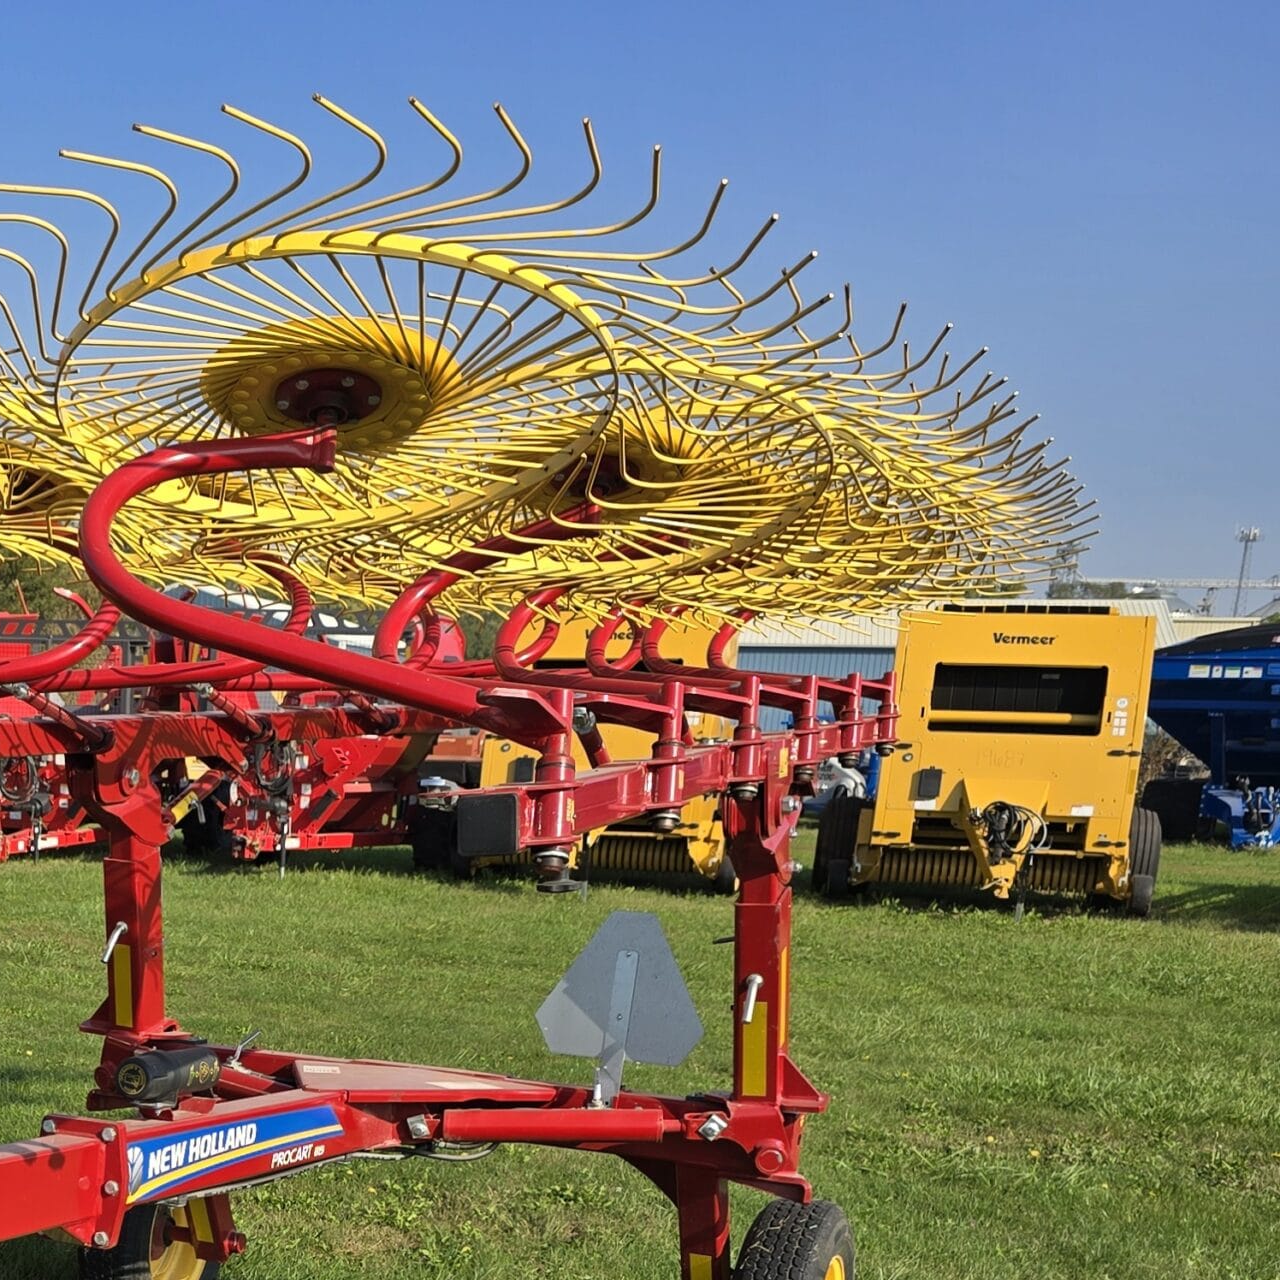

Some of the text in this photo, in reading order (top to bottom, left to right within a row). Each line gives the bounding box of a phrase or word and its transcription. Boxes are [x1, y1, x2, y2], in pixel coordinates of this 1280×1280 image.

[993, 632, 1056, 645] Vermeer
[147, 1123, 257, 1178] NEW HOLLAND
[271, 1143, 314, 1169] PROCART
